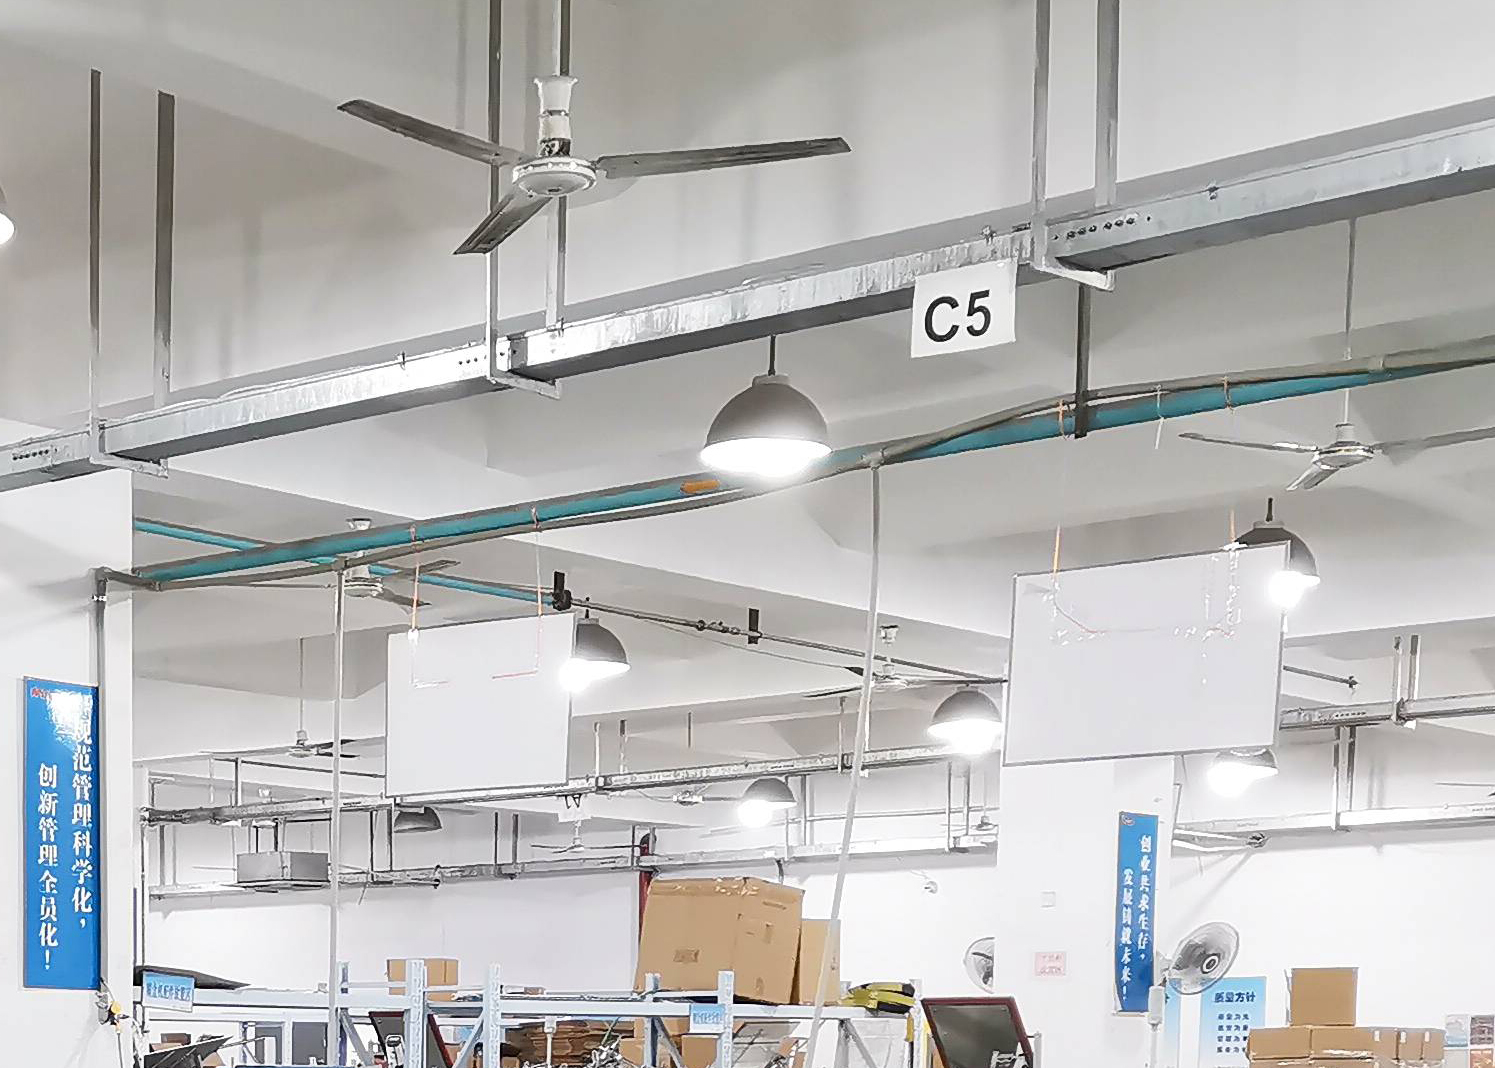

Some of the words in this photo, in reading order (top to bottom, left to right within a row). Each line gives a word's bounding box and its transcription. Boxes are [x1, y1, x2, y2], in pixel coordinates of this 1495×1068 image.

[925, 289, 991, 343] C5
[38, 763, 59, 970] 创新管理全员化！
